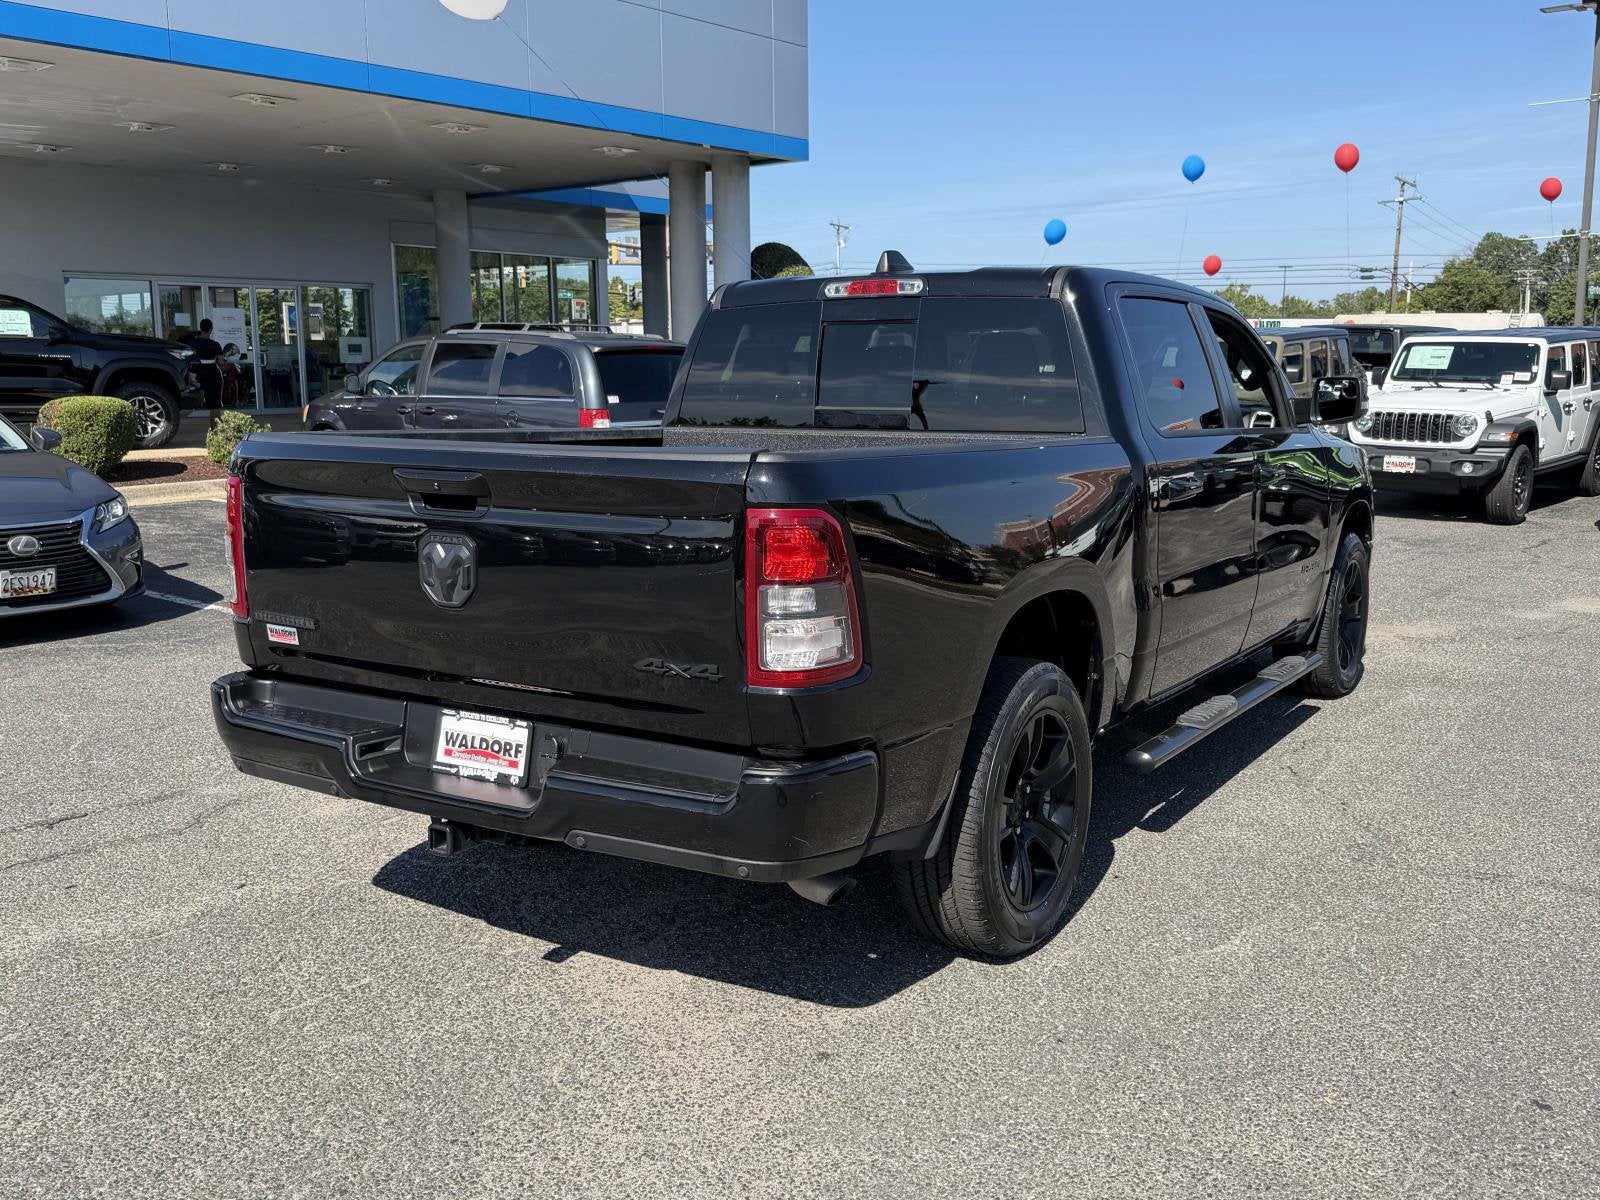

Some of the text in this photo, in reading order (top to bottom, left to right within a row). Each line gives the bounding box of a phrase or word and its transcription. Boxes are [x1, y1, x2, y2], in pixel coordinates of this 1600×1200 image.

[430, 535, 463, 544] RAM
[2, 572, 54, 593] 2ES1947
[268, 627, 297, 637] WALDORF
[445, 731, 524, 759] WALDORF
[471, 754, 487, 763] Dodge
